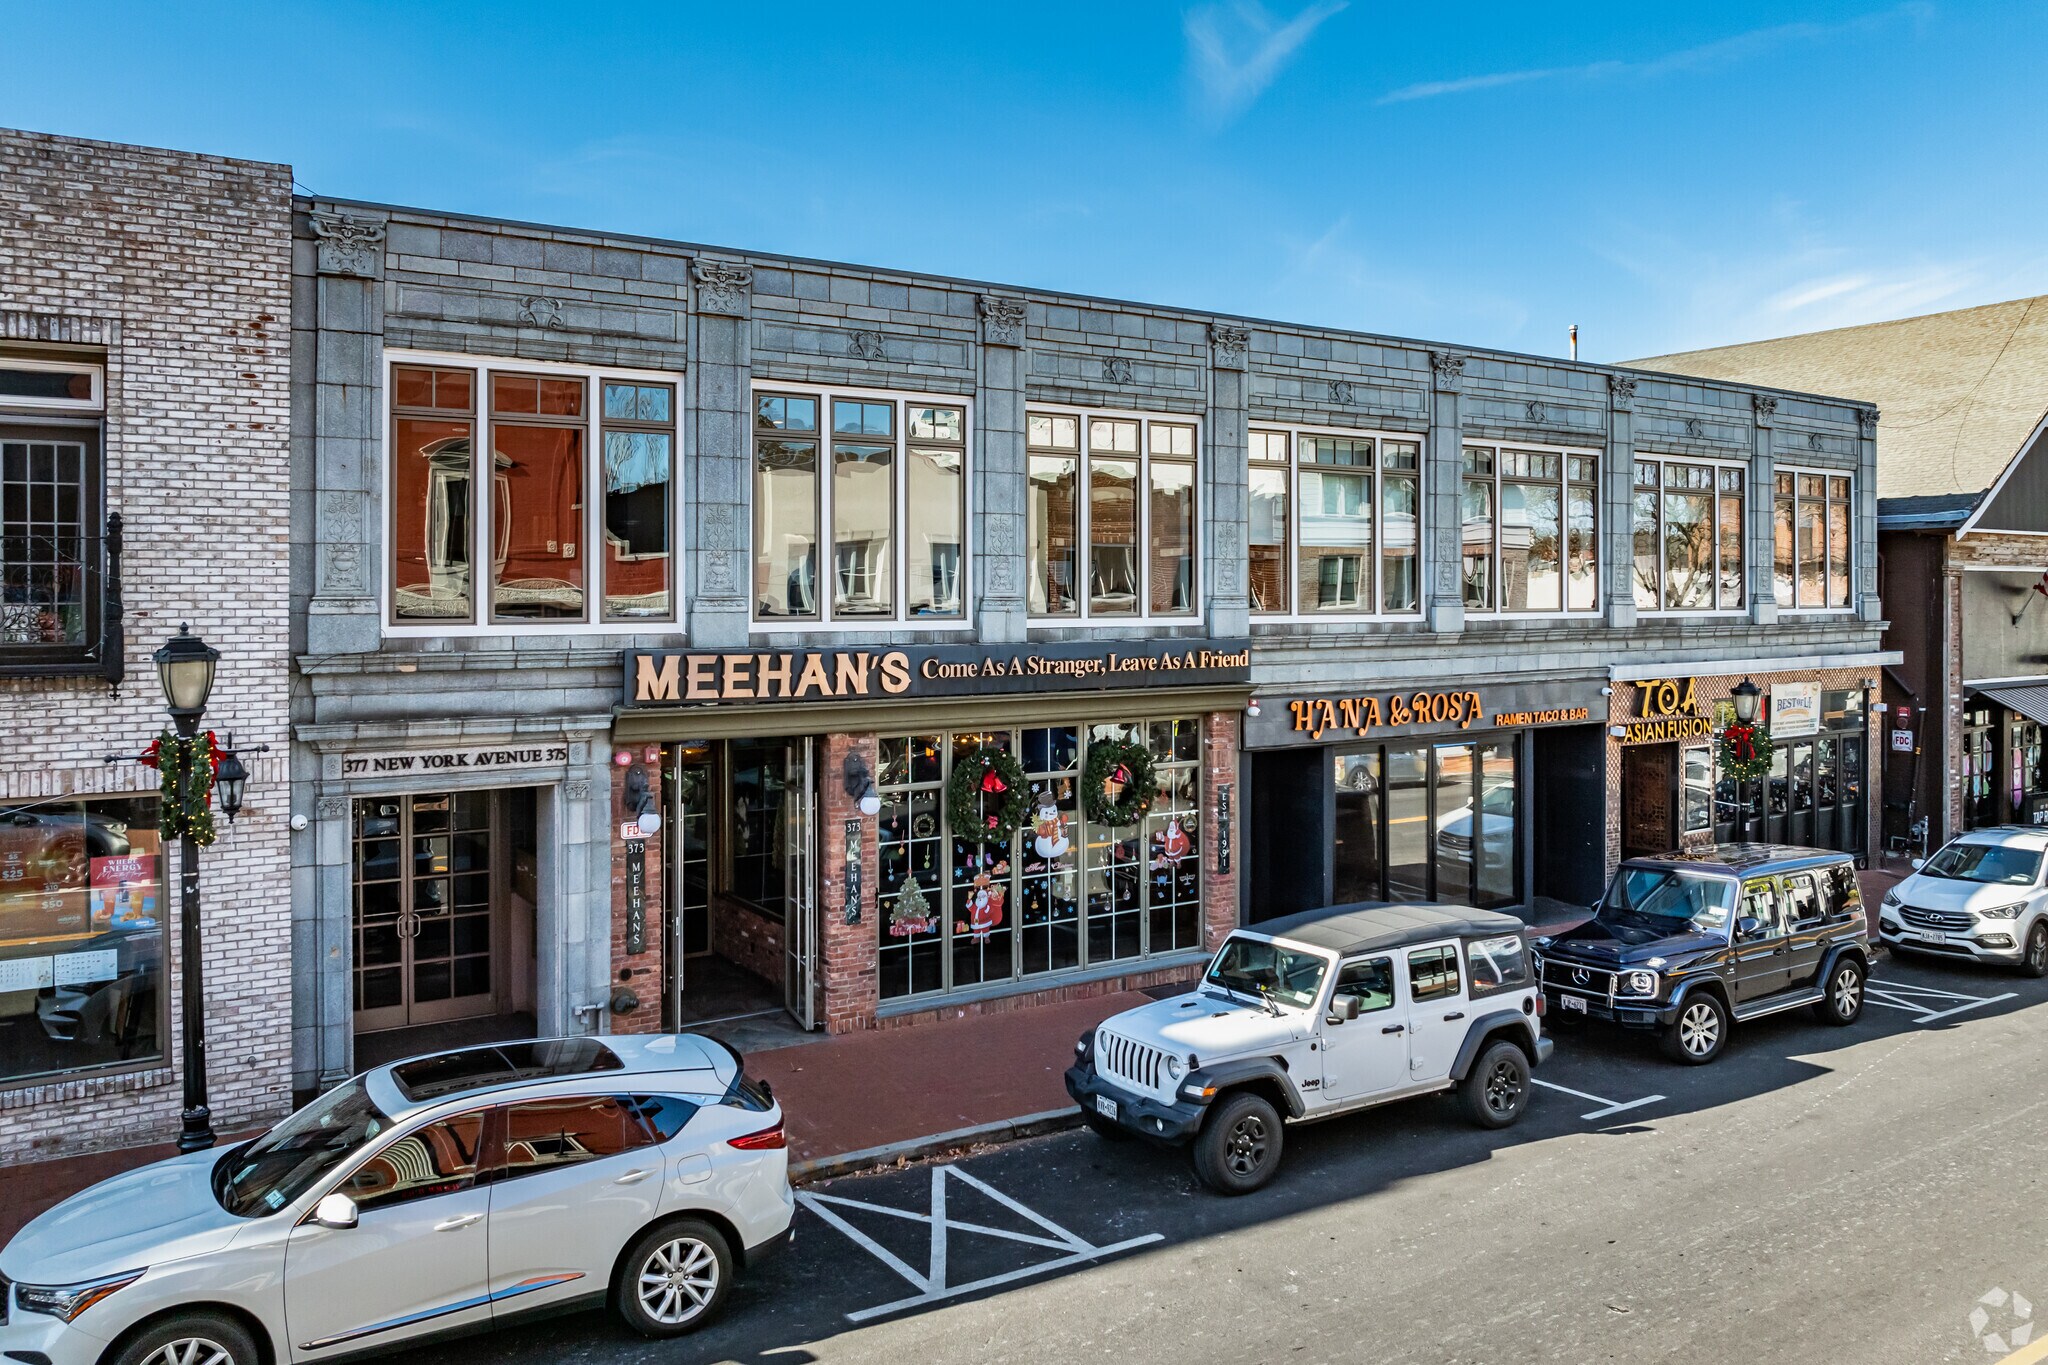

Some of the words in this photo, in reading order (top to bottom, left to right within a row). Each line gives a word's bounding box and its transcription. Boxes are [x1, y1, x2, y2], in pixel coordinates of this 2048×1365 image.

[921, 658, 978, 679] Come
[981, 656, 1005, 677] As
[1008, 655, 1024, 676] A
[1027, 655, 1106, 679] Stranger,
[1109, 652, 1158, 672] Leave
[1160, 651, 1181, 670] As
[1184, 650, 1197, 670] A
[1200, 649, 1249, 669] Friend
[635, 651, 912, 701] MEEHAN'S
[1777, 697, 1797, 711] BEST
[1290, 696, 1383, 740] HANA
[1389, 694, 1412, 727] &
[1412, 691, 1483, 729] ROSA
[1496, 712, 1532, 726] RAMEN
[1533, 710, 1559, 723] TACO
[1560, 708, 1569, 721] &
[1569, 707, 1588, 720] BAR
[1624, 722, 1665, 743] ASIAN
[1667, 717, 1712, 739] FUSION
[1895, 736, 1910, 745] FDC
[344, 758, 368, 773] 377
[373, 756, 416, 771] NEW
[419, 753, 470, 769] YORK
[473, 749, 543, 766] AVENUE
[546, 748, 567, 761] 375
[846, 822, 861, 833] 373
[628, 842, 645, 854] 373
[102, 863, 143, 873] ENERGY
[108, 858, 137, 866] WHERE
[2, 869, 24, 880] $25
[850, 840, 858, 916] MEEHANS
[41, 900, 64, 910] $50
[632, 862, 641, 945] MEEHANS
[1301, 1079, 1320, 1088] Jeep
